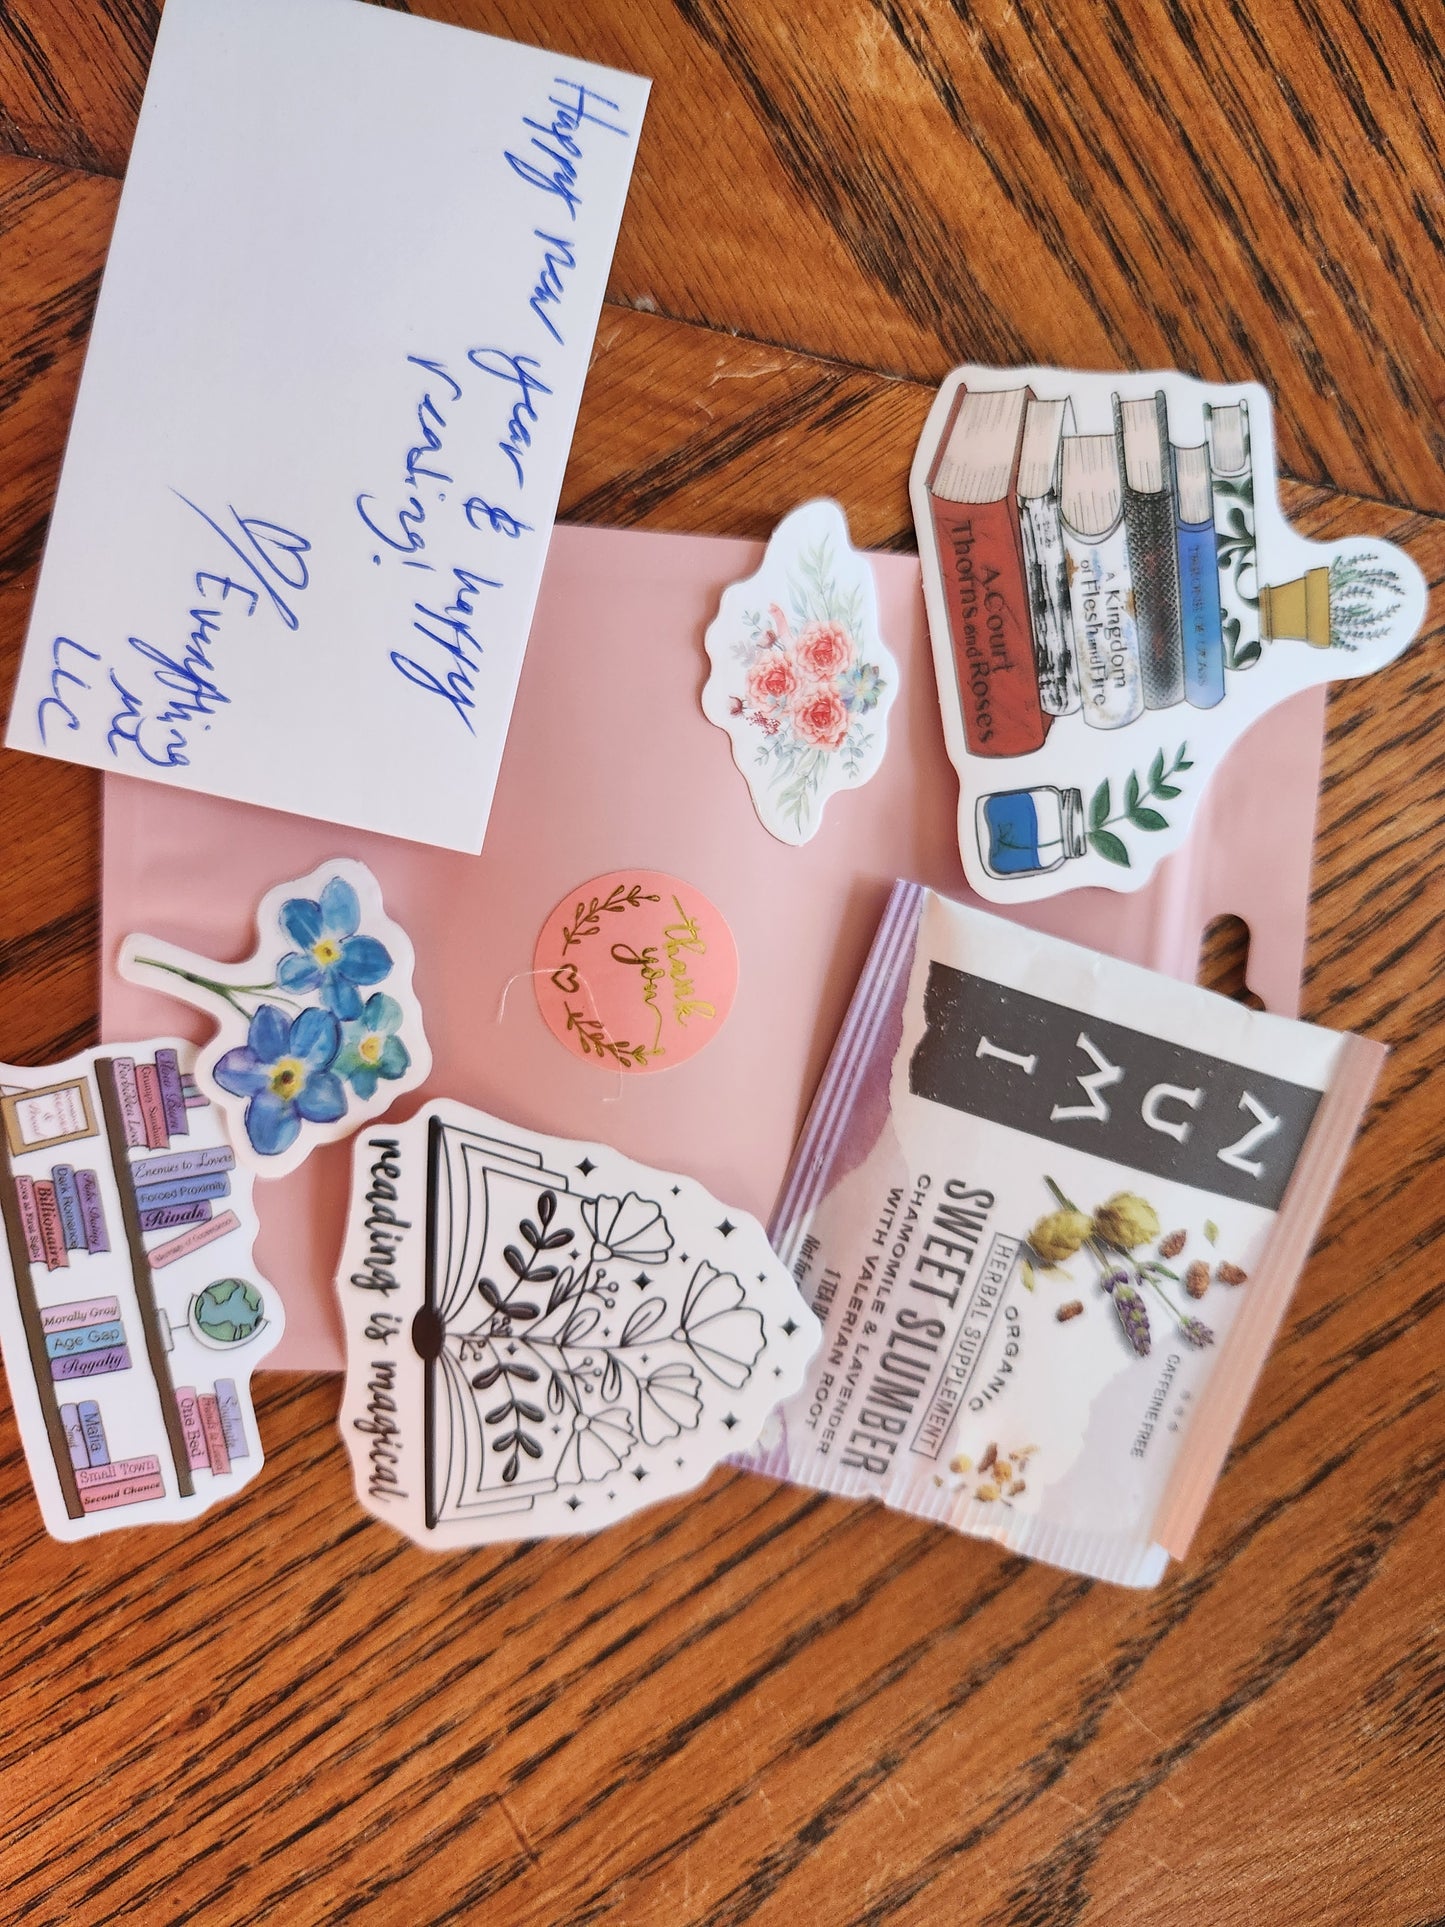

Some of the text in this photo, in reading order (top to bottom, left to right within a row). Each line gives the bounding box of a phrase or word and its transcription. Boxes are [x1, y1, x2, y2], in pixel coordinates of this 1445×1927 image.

[503, 78, 629, 222] Happy
[529, 230, 575, 346] new
[467, 350, 552, 490] year
[1081, 560, 1094, 576] of
[951, 520, 995, 744] Thorns and Roses
[983, 592, 1017, 673] Court
[1080, 580, 1104, 636] Flesh
[1104, 572, 1128, 689] A Kingdom
[389, 571, 503, 738] happy
[1091, 664, 1109, 706] Fire
[611, 944, 665, 1050] you
[662, 894, 716, 1028] thank
[118, 1063, 141, 1147] Forbidden Love
[148, 1106, 162, 1147] Sunshine
[974, 1032, 1281, 1179] NUMI
[20, 1178, 31, 1200] Love
[57, 1169, 79, 1250] Dark Romance
[135, 1162, 179, 1179] Enemies
[141, 1180, 229, 1203] Forced Proximity
[26, 1213, 37, 1234] First
[29, 1236, 42, 1259] Sight
[38, 1188, 64, 1267] Billionaire
[145, 1205, 206, 1228] Rivals
[801, 1234, 821, 1260] Not
[43, 1311, 87, 1328] Morally
[351, 1139, 412, 1500] reading is magical
[805, 1188, 905, 1431] WITH VALERIAN ROOT
[814, 1279, 839, 1304] TEA
[816, 1174, 932, 1455] CHAMOMILE & LAVENDER
[839, 1179, 995, 1476] SWEET SLUMBER
[54, 1328, 120, 1351] Age Gap
[62, 1352, 123, 1375] Royalty
[918, 1244, 1013, 1450] HERBAL SUPPLEMENT
[968, 1306, 1021, 1411] ORGANIC
[84, 1412, 105, 1453] Mafia
[181, 1398, 205, 1458] One Bed
[1131, 1354, 1181, 1458] CAFFEINE FREE
[79, 1461, 155, 1483] Small Town
[84, 1482, 161, 1505] Second Chance
